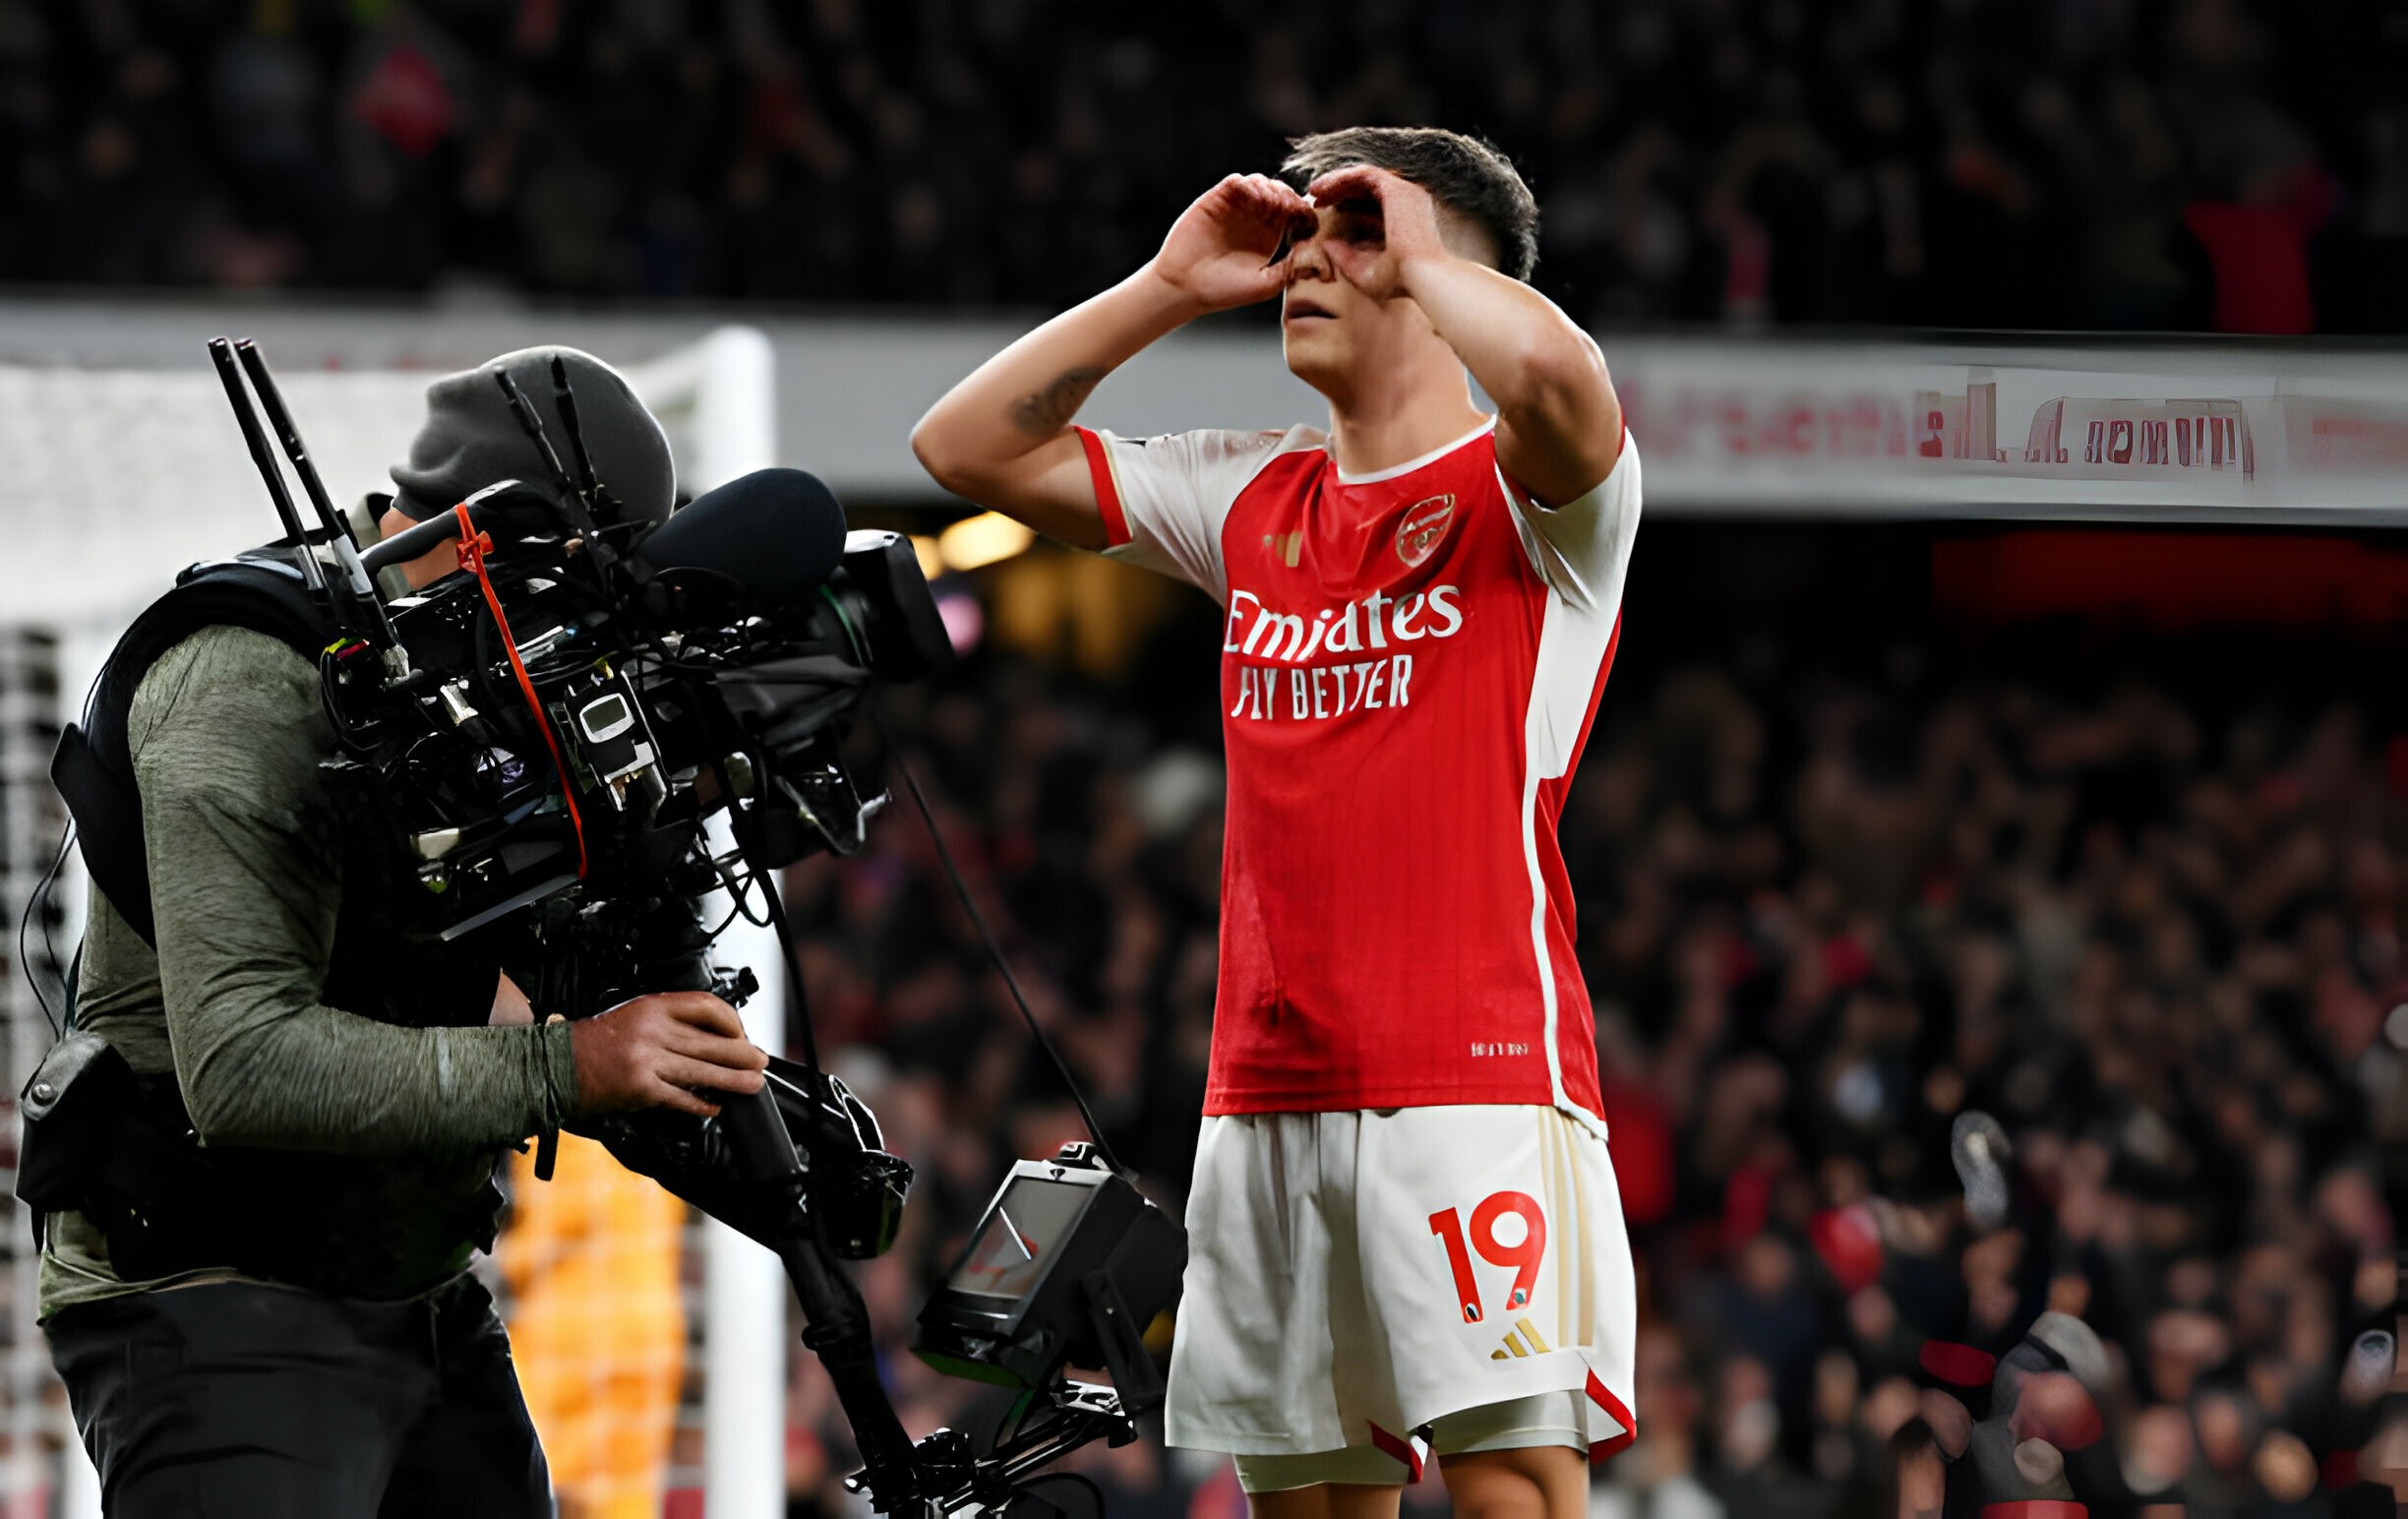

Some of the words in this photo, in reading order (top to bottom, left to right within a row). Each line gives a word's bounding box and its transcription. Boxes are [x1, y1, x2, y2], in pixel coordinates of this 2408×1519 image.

[1224, 584, 1464, 662] Emiates
[1292, 654, 1413, 720] BETTER
[1428, 1190, 1546, 1324] 19
